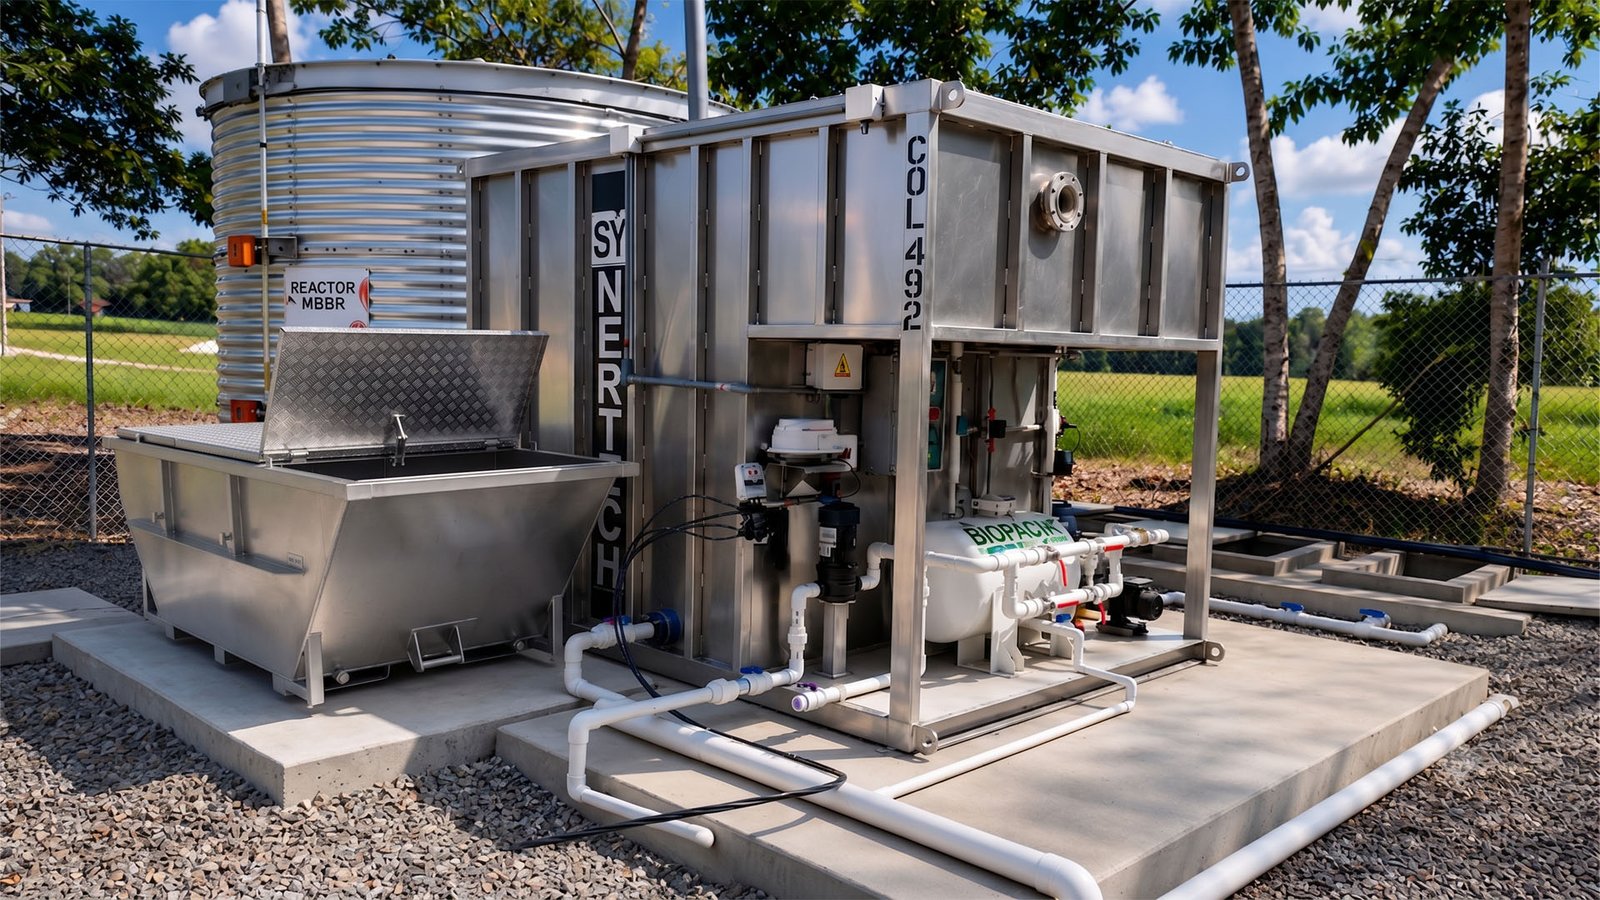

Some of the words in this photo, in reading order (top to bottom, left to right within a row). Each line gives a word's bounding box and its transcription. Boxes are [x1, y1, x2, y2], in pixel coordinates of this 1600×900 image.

[906, 135, 927, 230] COL
[290, 281, 356, 295] REACTOR
[302, 296, 346, 311] MBBR
[902, 236, 925, 331] 492
